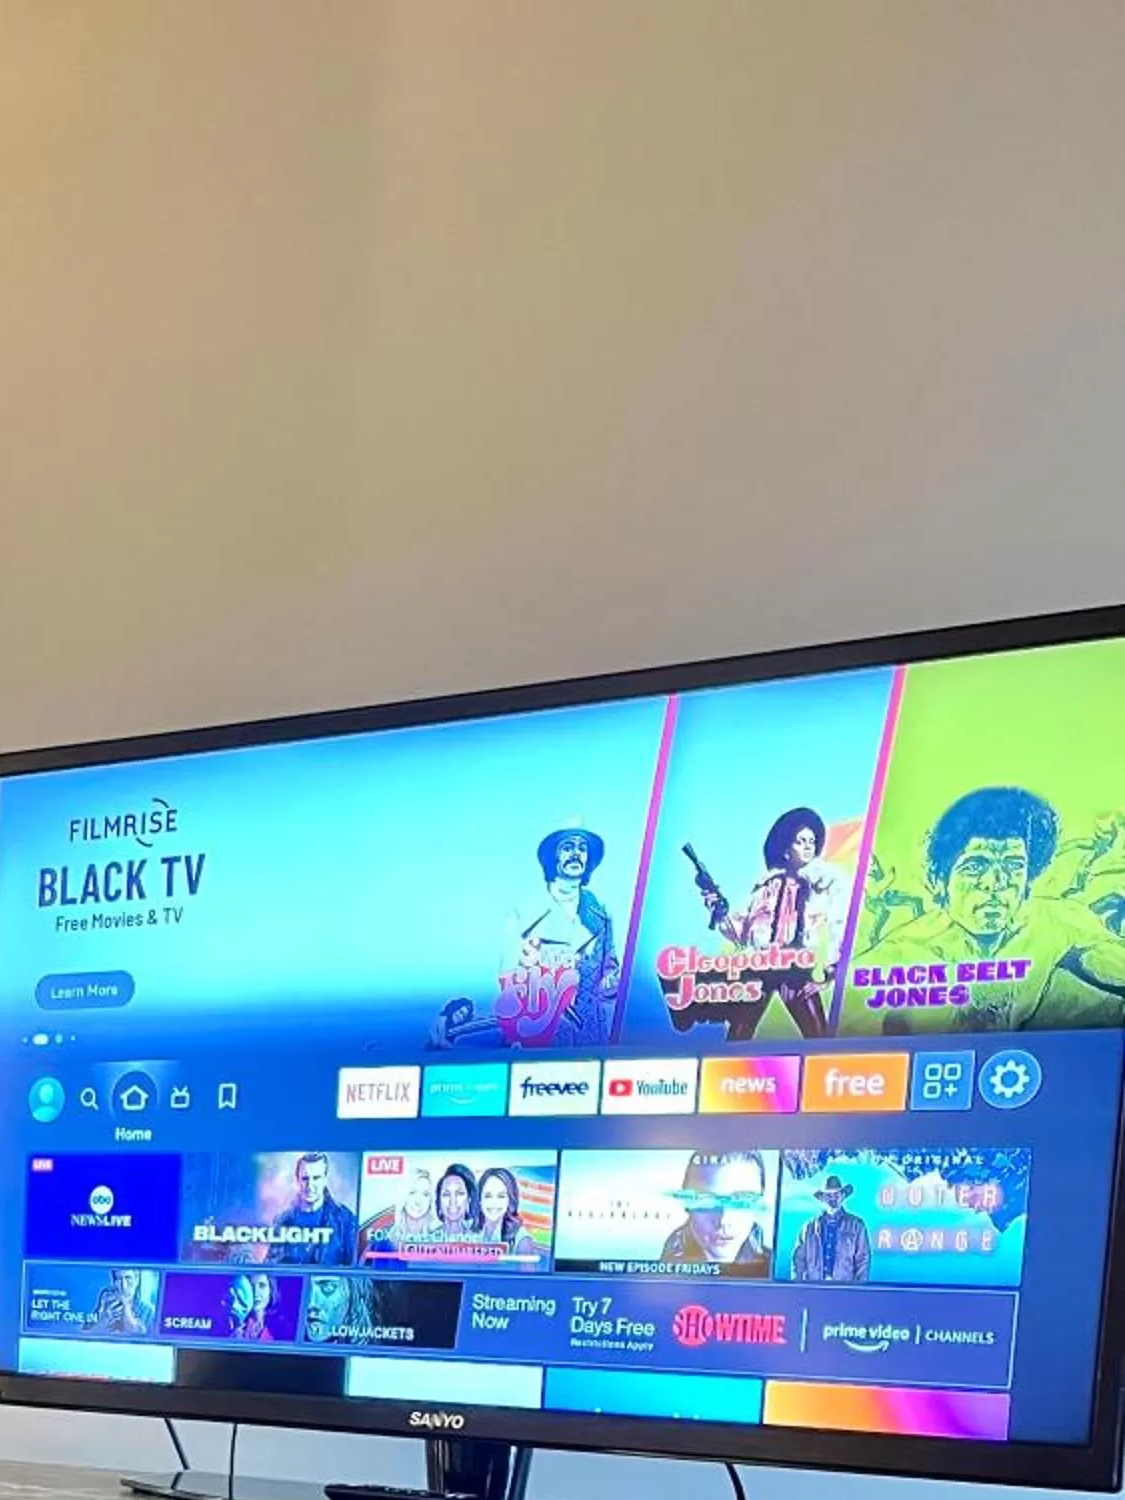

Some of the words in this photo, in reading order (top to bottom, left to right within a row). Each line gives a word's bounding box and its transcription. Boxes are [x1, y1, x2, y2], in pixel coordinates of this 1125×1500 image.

[69, 807, 178, 843] FILMRISE
[38, 858, 148, 908] BLACK
[160, 853, 206, 897] TV
[55, 915, 88, 932] Free
[92, 911, 144, 929] Movies
[146, 909, 158, 925] &
[162, 907, 184, 924] TV
[656, 946, 816, 980] Cleopatra
[853, 964, 948, 988] BLACK
[956, 960, 1032, 983] BELT
[50, 985, 84, 999] Learn
[86, 983, 118, 997] More
[667, 973, 763, 1010] Jones
[866, 984, 971, 1009] JONES
[346, 1082, 411, 1103] NETFLIX
[520, 1076, 590, 1099] freevee
[636, 1078, 688, 1096] YouTube
[720, 1076, 776, 1093] news
[824, 1068, 886, 1096] free
[114, 1127, 153, 1141] Home
[370, 1158, 401, 1173] LIVE
[880, 1183, 998, 1207] OUTER
[193, 1225, 335, 1243] BLACKLIGHT
[877, 1227, 995, 1251] RANGE
[599, 1261, 625, 1273] NEW
[627, 1262, 673, 1275] EPISODE
[674, 1263, 721, 1276] FRIDAYS
[32, 1299, 50, 1310] LET
[51, 1300, 71, 1310] THE
[472, 1294, 556, 1316] Streaming
[571, 1296, 598, 1317] Try
[600, 1296, 612, 1315] 7
[31, 1311, 61, 1322] RIGHT
[63, 1312, 86, 1323] ONE
[164, 1317, 212, 1330] SCREAM
[472, 1313, 510, 1330] Now
[570, 1316, 613, 1337] Days
[616, 1317, 655, 1337] Free
[673, 1305, 788, 1346] SHOWTIME
[823, 1322, 866, 1340] prime
[868, 1323, 910, 1341] video
[925, 1328, 995, 1345] CHANNELS
[627, 1341, 654, 1352] Apply
[409, 1411, 465, 1430] SANYO
